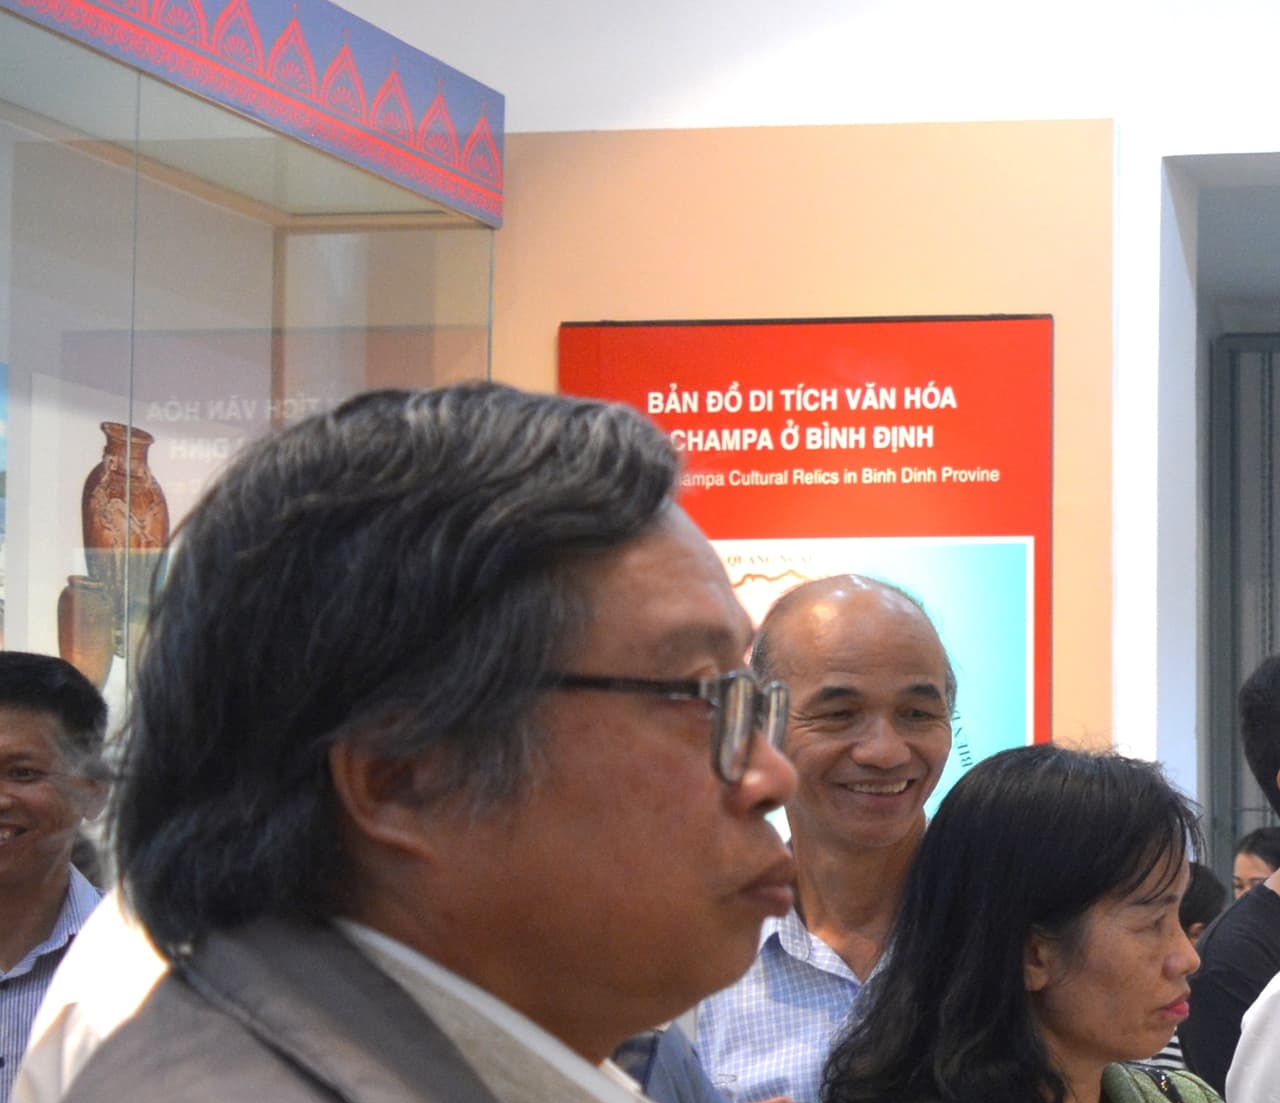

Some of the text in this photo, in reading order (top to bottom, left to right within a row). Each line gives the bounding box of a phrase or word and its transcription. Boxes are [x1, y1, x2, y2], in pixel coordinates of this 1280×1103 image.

[647, 380, 958, 414] BẢN ĐỒ DI TÍCH VĂN HÓA
[670, 427, 774, 453] CHAMPA
[805, 422, 866, 450] BÌNH
[873, 425, 934, 453] ĐỊNH
[677, 465, 1001, 491] ampa Cultural Relics in Binh Dinh Provine
